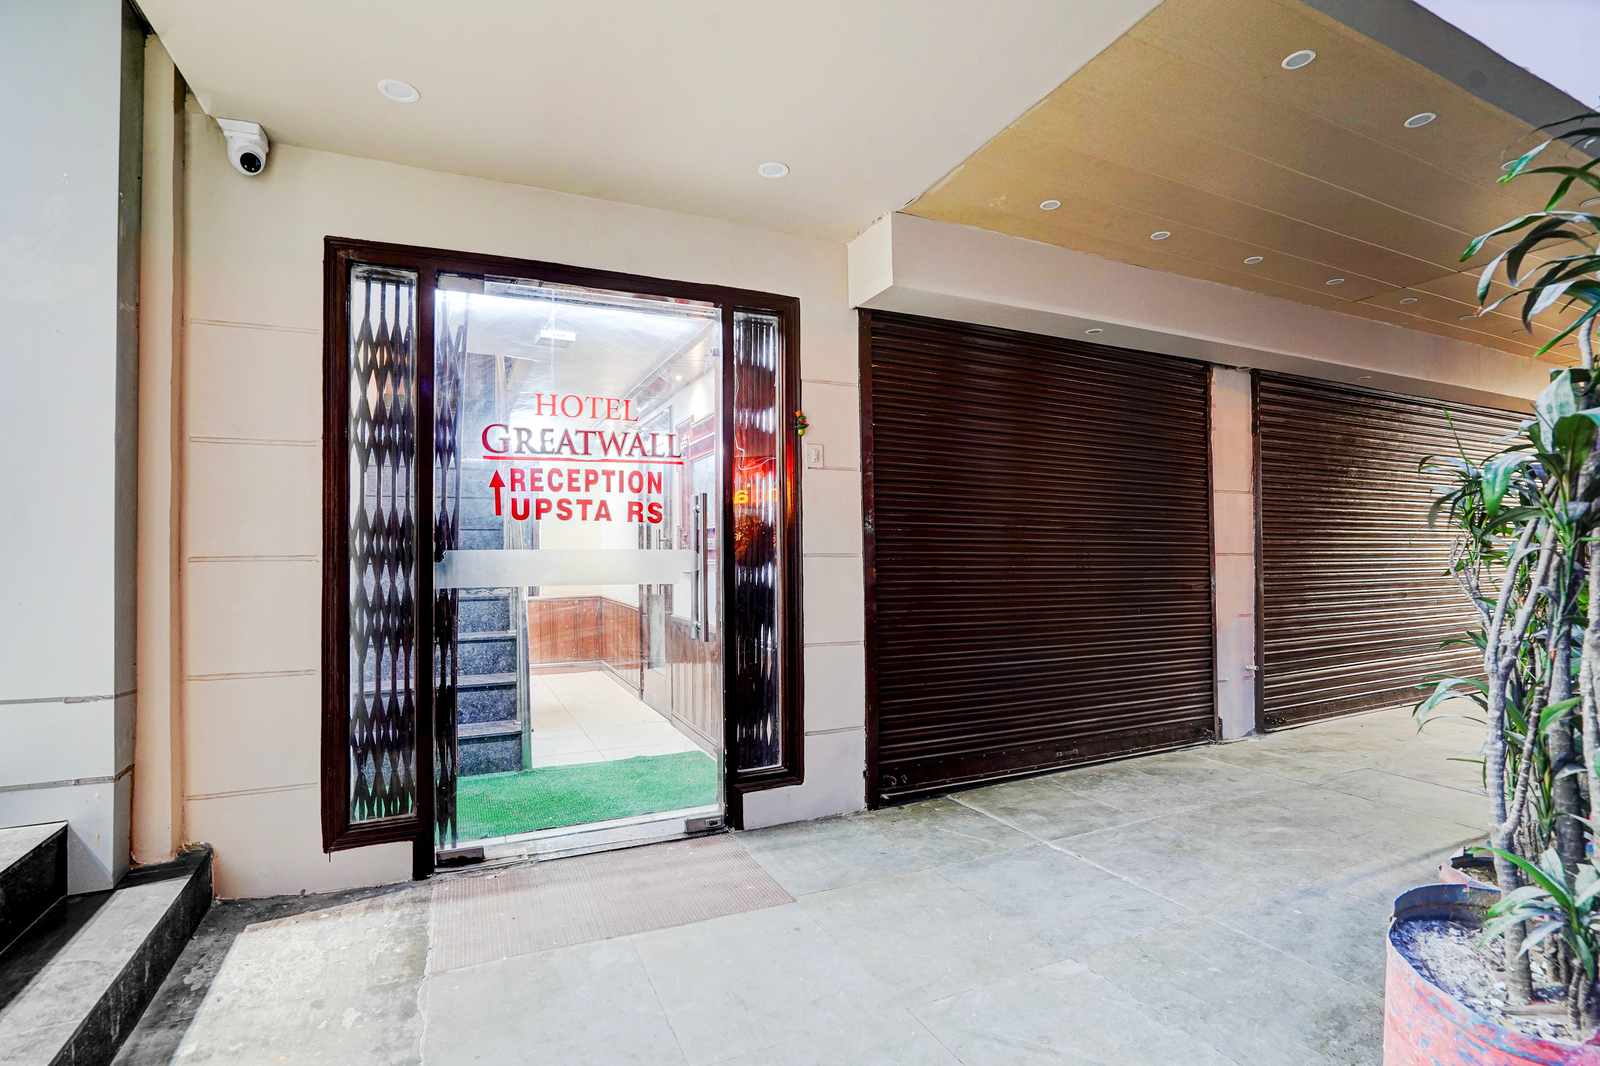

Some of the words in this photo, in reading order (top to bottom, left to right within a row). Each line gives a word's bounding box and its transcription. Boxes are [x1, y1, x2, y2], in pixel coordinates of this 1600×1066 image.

[534, 393, 638, 422] HOTEL
[481, 423, 683, 459] GREATWALL
[510, 467, 662, 495] RECEPTION
